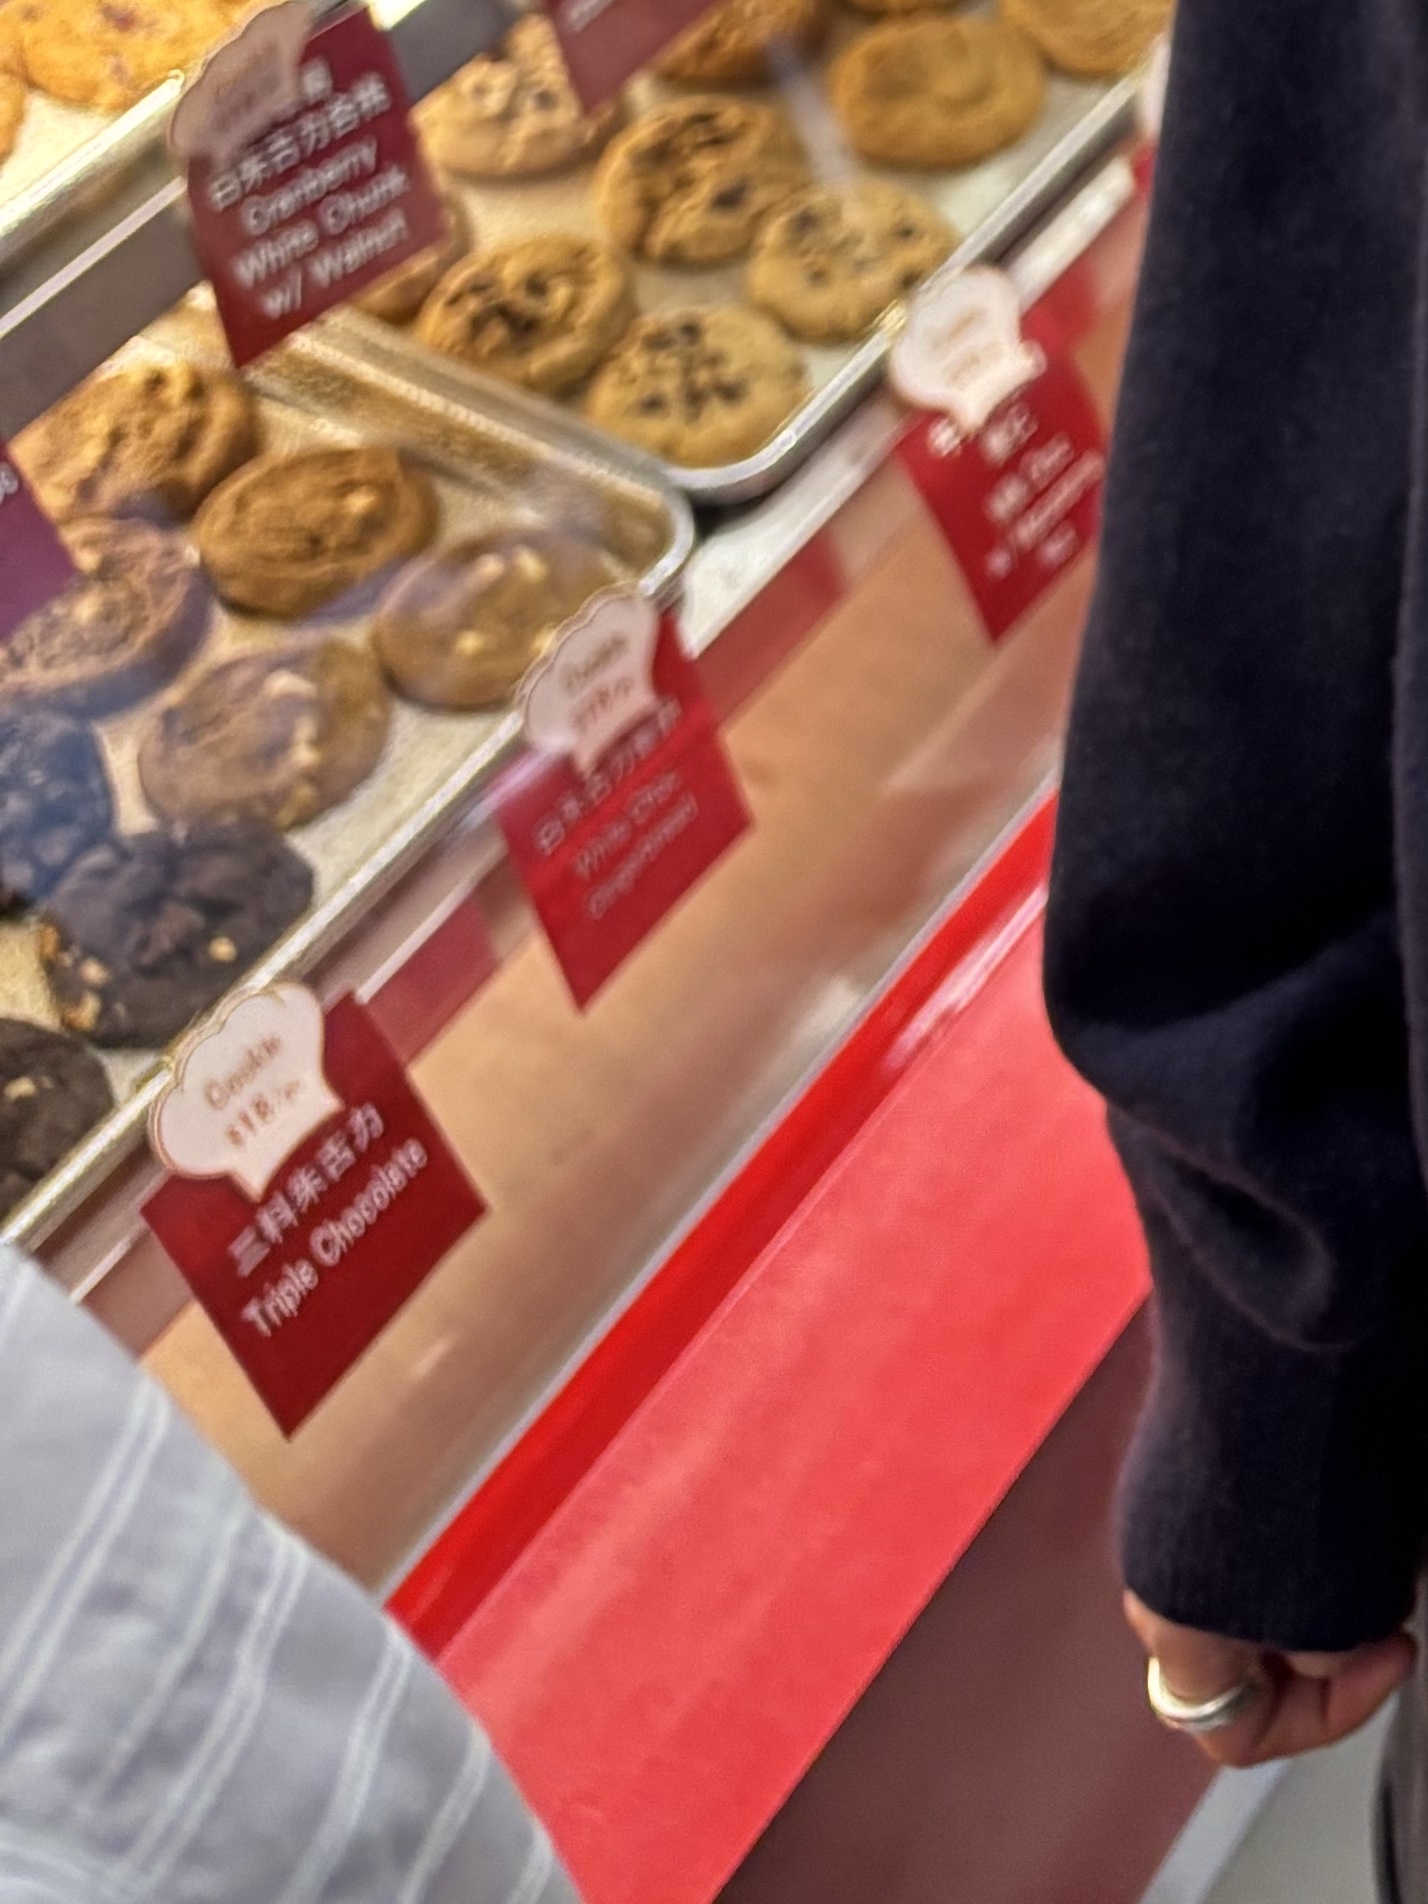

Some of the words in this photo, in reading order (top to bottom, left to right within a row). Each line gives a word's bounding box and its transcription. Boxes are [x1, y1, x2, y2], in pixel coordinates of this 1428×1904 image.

[234, 219, 320, 289] White
[241, 1255, 320, 1339] Triple
[310, 1137, 430, 1267] Chocolate
